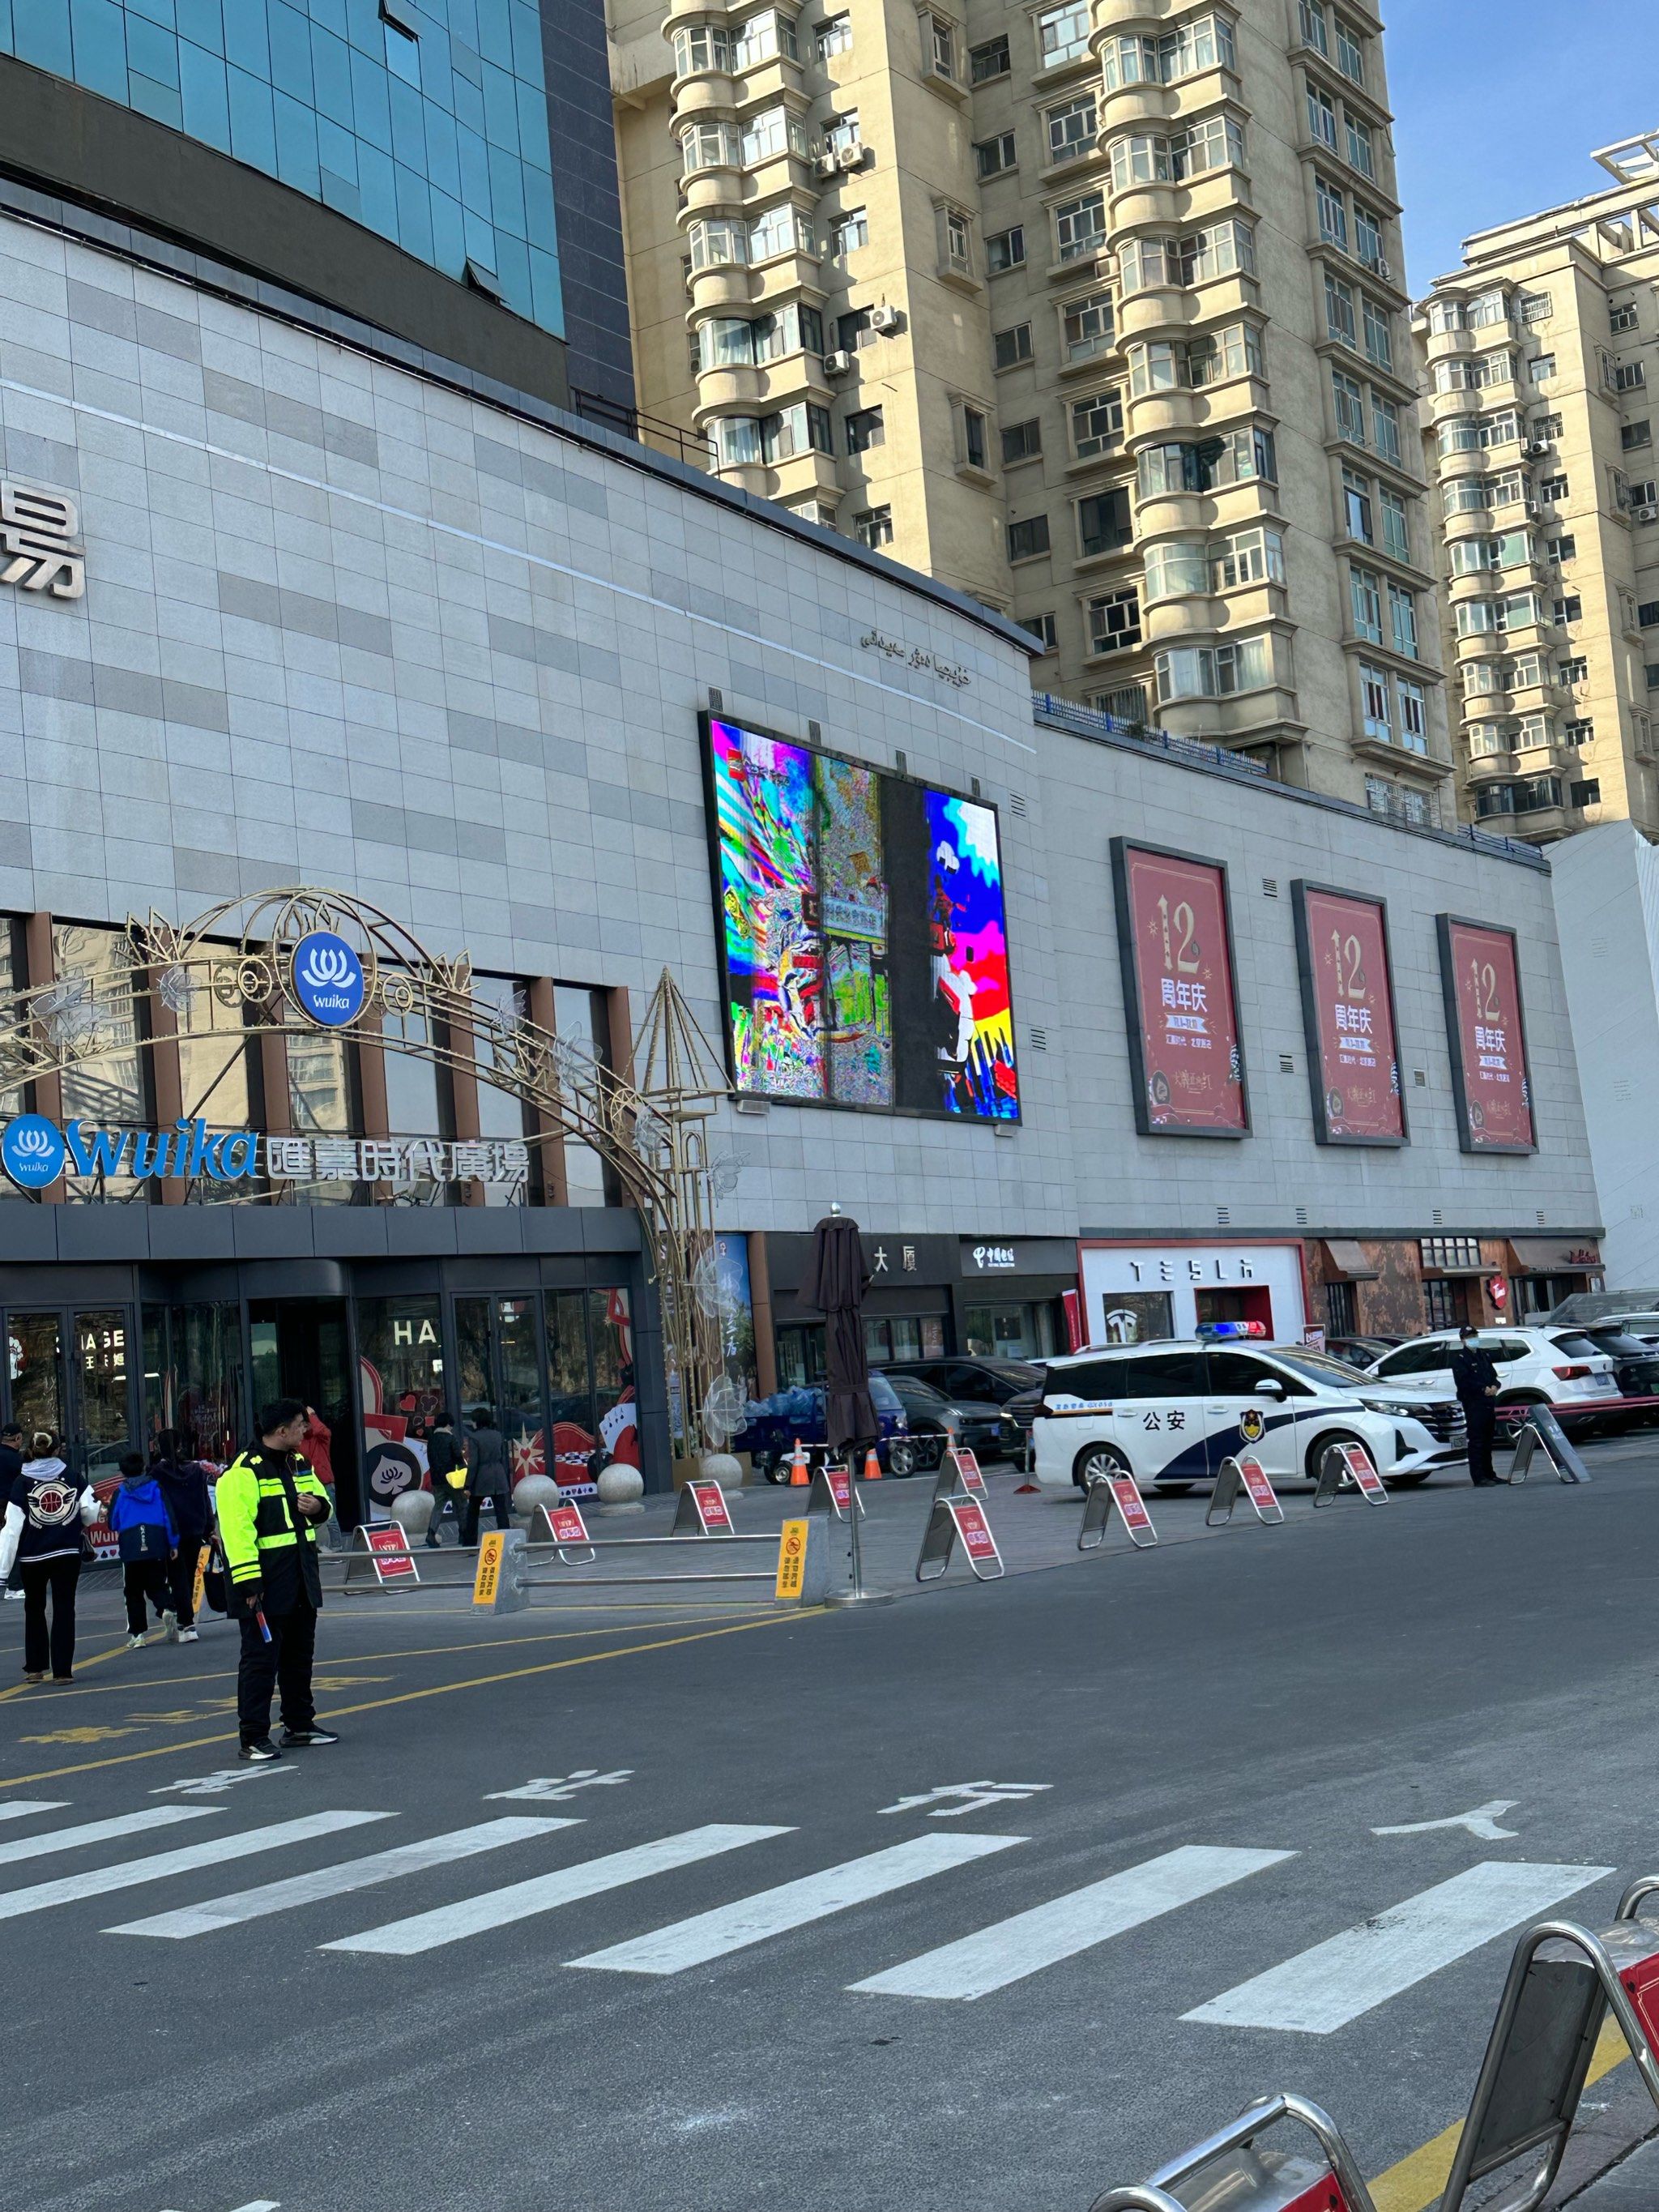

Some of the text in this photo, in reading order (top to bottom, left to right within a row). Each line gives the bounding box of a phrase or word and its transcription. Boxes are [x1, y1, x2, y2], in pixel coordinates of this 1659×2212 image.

[1157, 895, 1199, 974] 12
[1330, 929, 1367, 999] 12
[1160, 977, 1208, 1012] 周年庆
[1470, 958, 1499, 1021] 12
[1335, 1004, 1373, 1034] 周年庆
[267, 1137, 530, 1182] 匯嘉時代廣場
[874, 1245, 917, 1272] 大厦
[1130, 1258, 1254, 1282] TESLA
[1143, 1411, 1185, 1431] 公安
